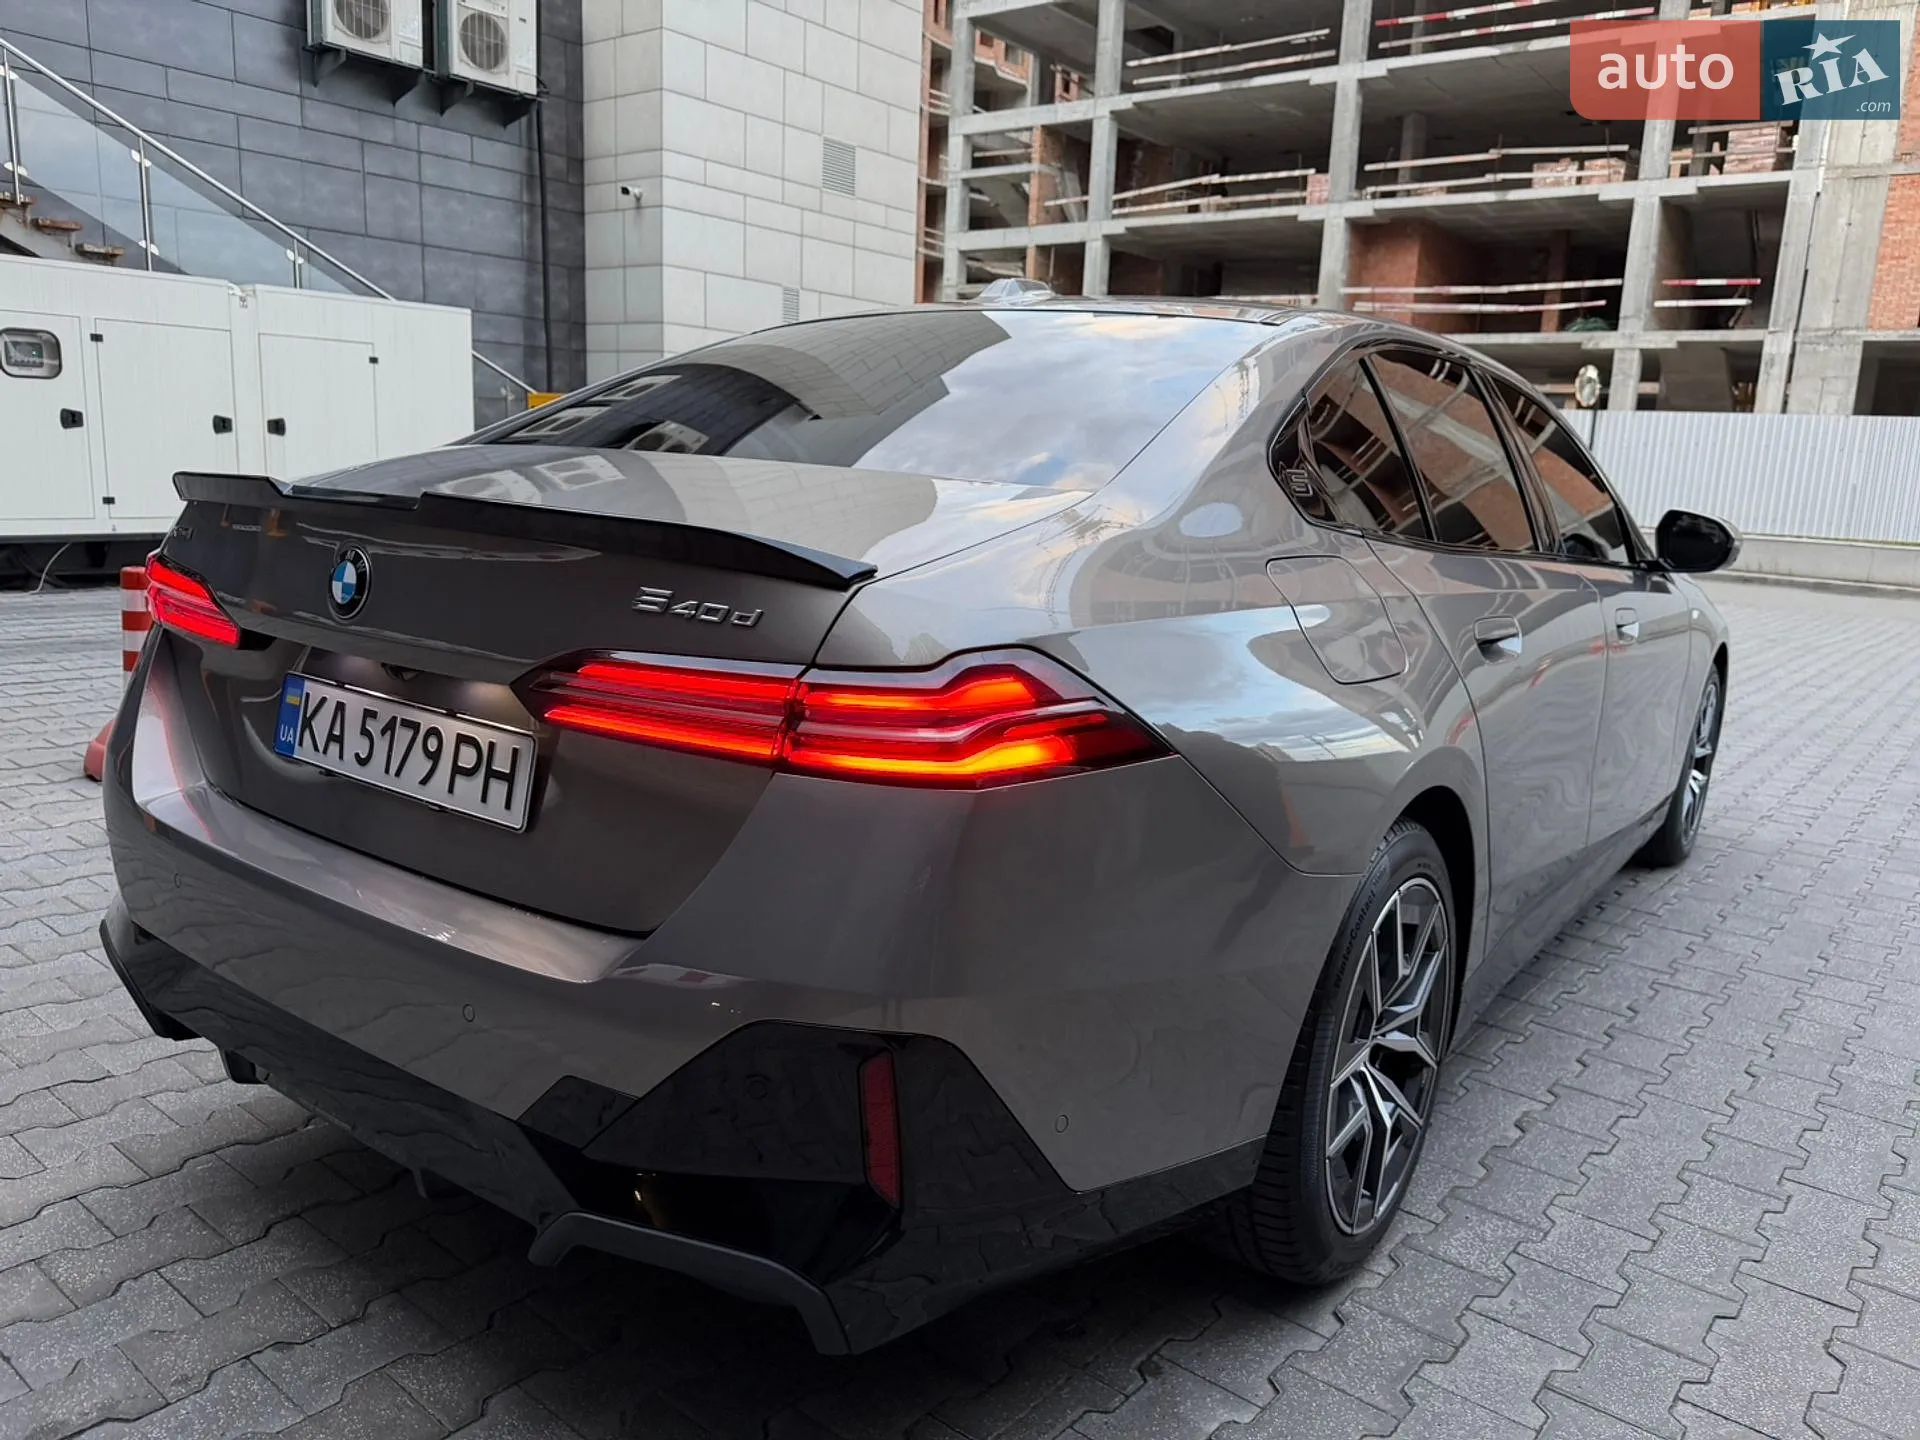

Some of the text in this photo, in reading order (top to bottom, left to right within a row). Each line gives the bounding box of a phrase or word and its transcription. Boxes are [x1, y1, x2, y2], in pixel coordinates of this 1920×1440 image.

[632, 586, 764, 627] 540d
[279, 724, 295, 743] UA
[298, 692, 519, 811] KA 5179 PH
